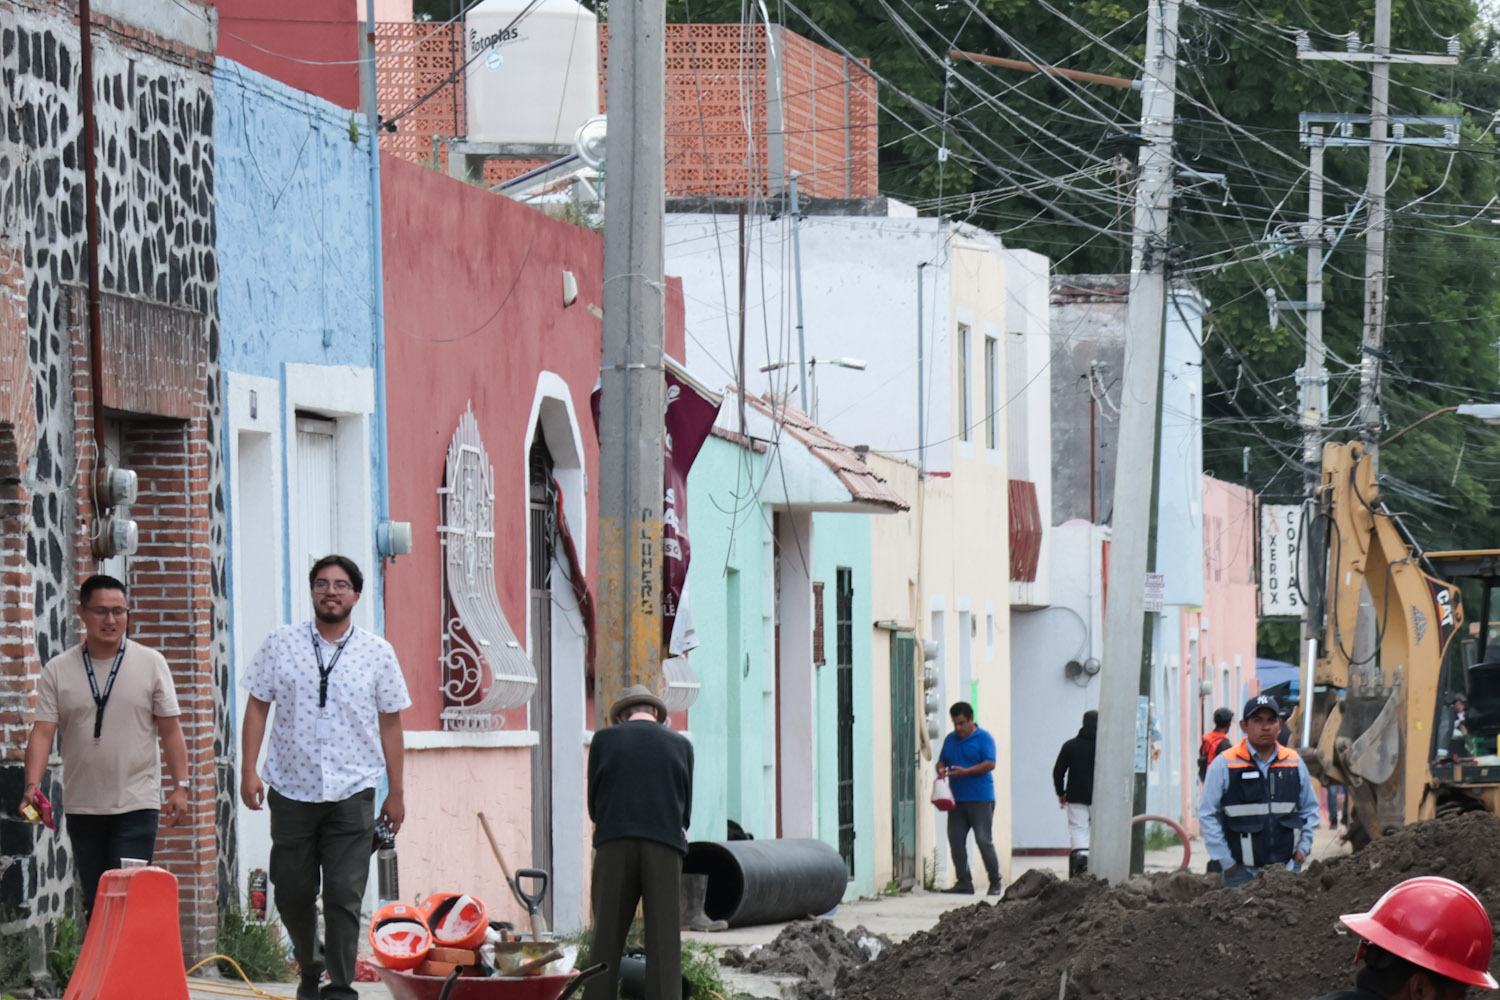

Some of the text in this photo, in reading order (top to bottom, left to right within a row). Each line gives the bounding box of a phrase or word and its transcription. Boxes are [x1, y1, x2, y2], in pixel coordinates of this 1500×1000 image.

[1269, 535, 1279, 604] XEROX
[1287, 511, 1298, 606] COPIAS
[1436, 589, 1454, 627] CAT
